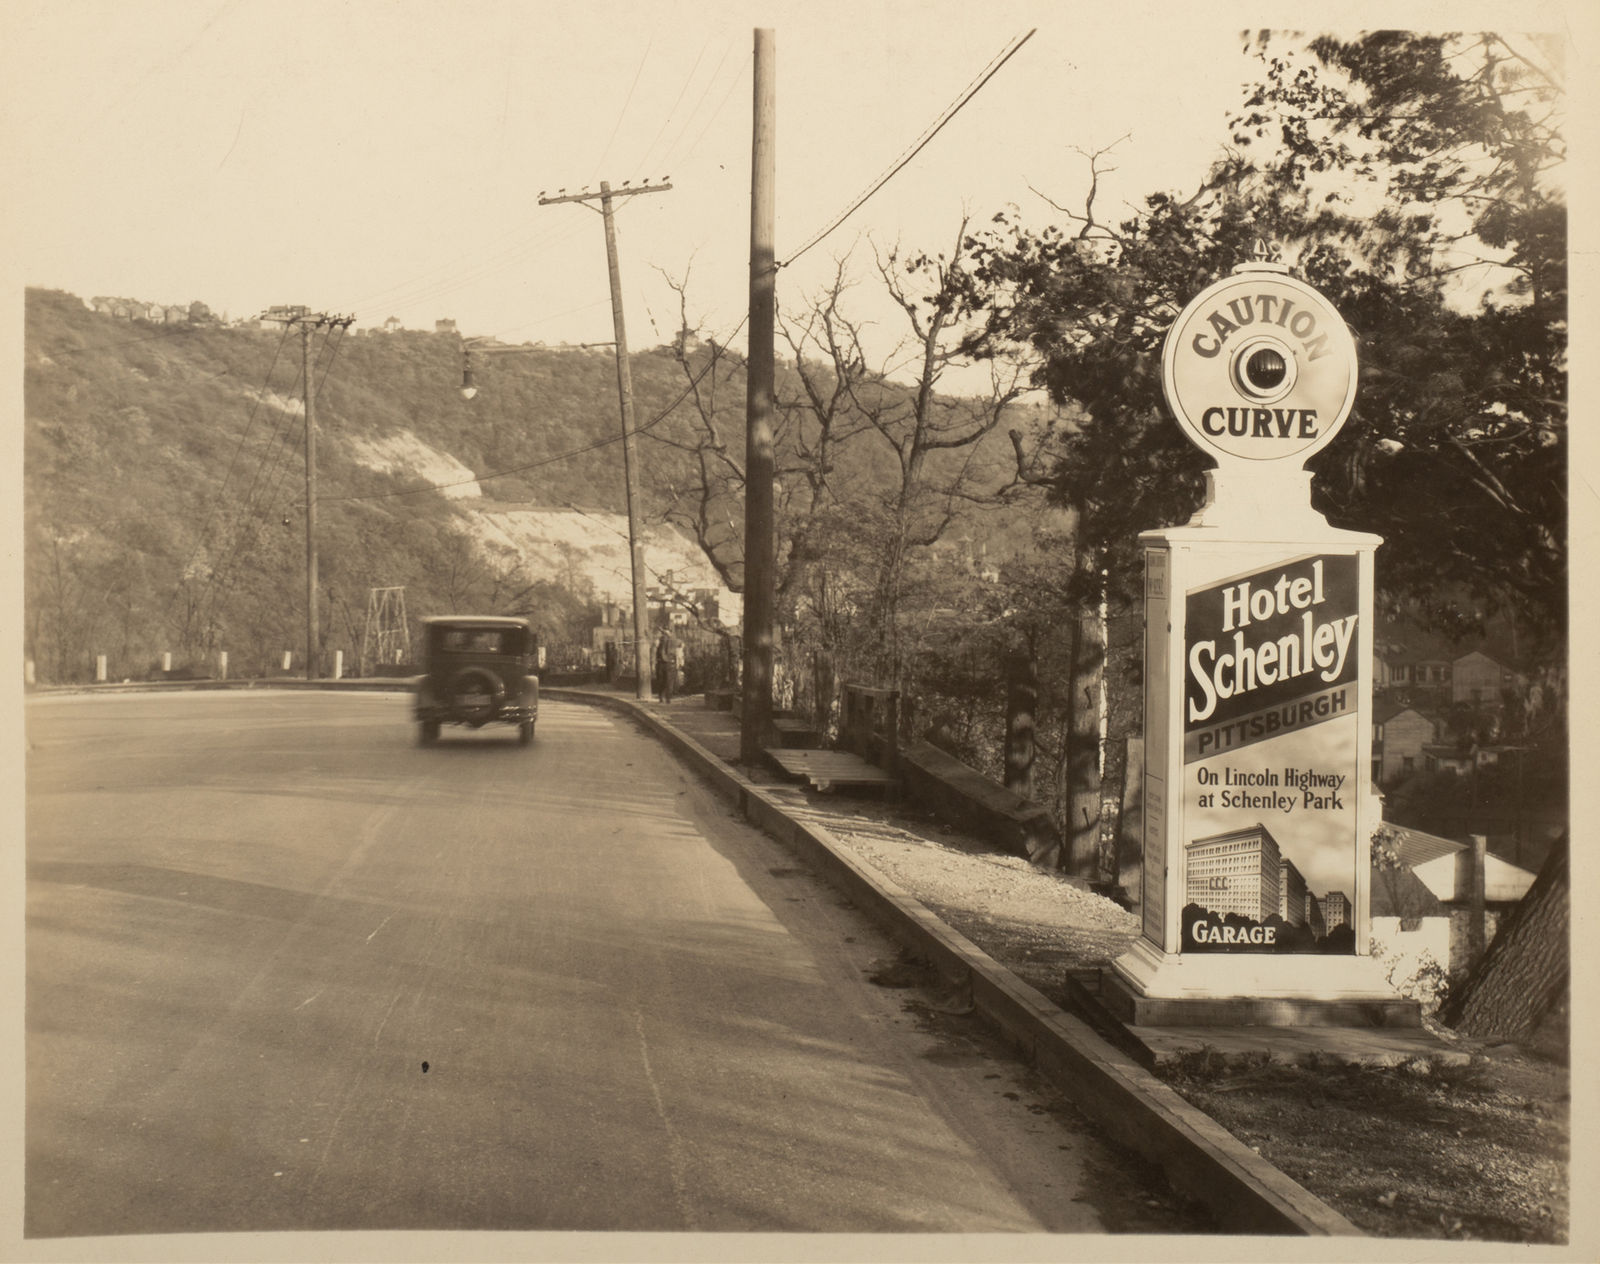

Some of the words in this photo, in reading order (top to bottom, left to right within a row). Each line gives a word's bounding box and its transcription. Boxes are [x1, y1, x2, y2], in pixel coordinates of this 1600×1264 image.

[1192, 294, 1332, 362] CAUTION
[1202, 407, 1319, 439] CURVE
[1222, 560, 1326, 632] Hotel
[1189, 611, 1358, 723] Schenley
[1199, 690, 1346, 754] PITTSBURGH
[1197, 767, 1219, 786] On
[1225, 767, 1279, 787] Lincoln
[1284, 768, 1346, 791] Highway
[1198, 793, 1214, 808] at
[1221, 790, 1297, 813] Schenley
[1303, 791, 1344, 810] Park
[1191, 920, 1276, 944] GARAGE
